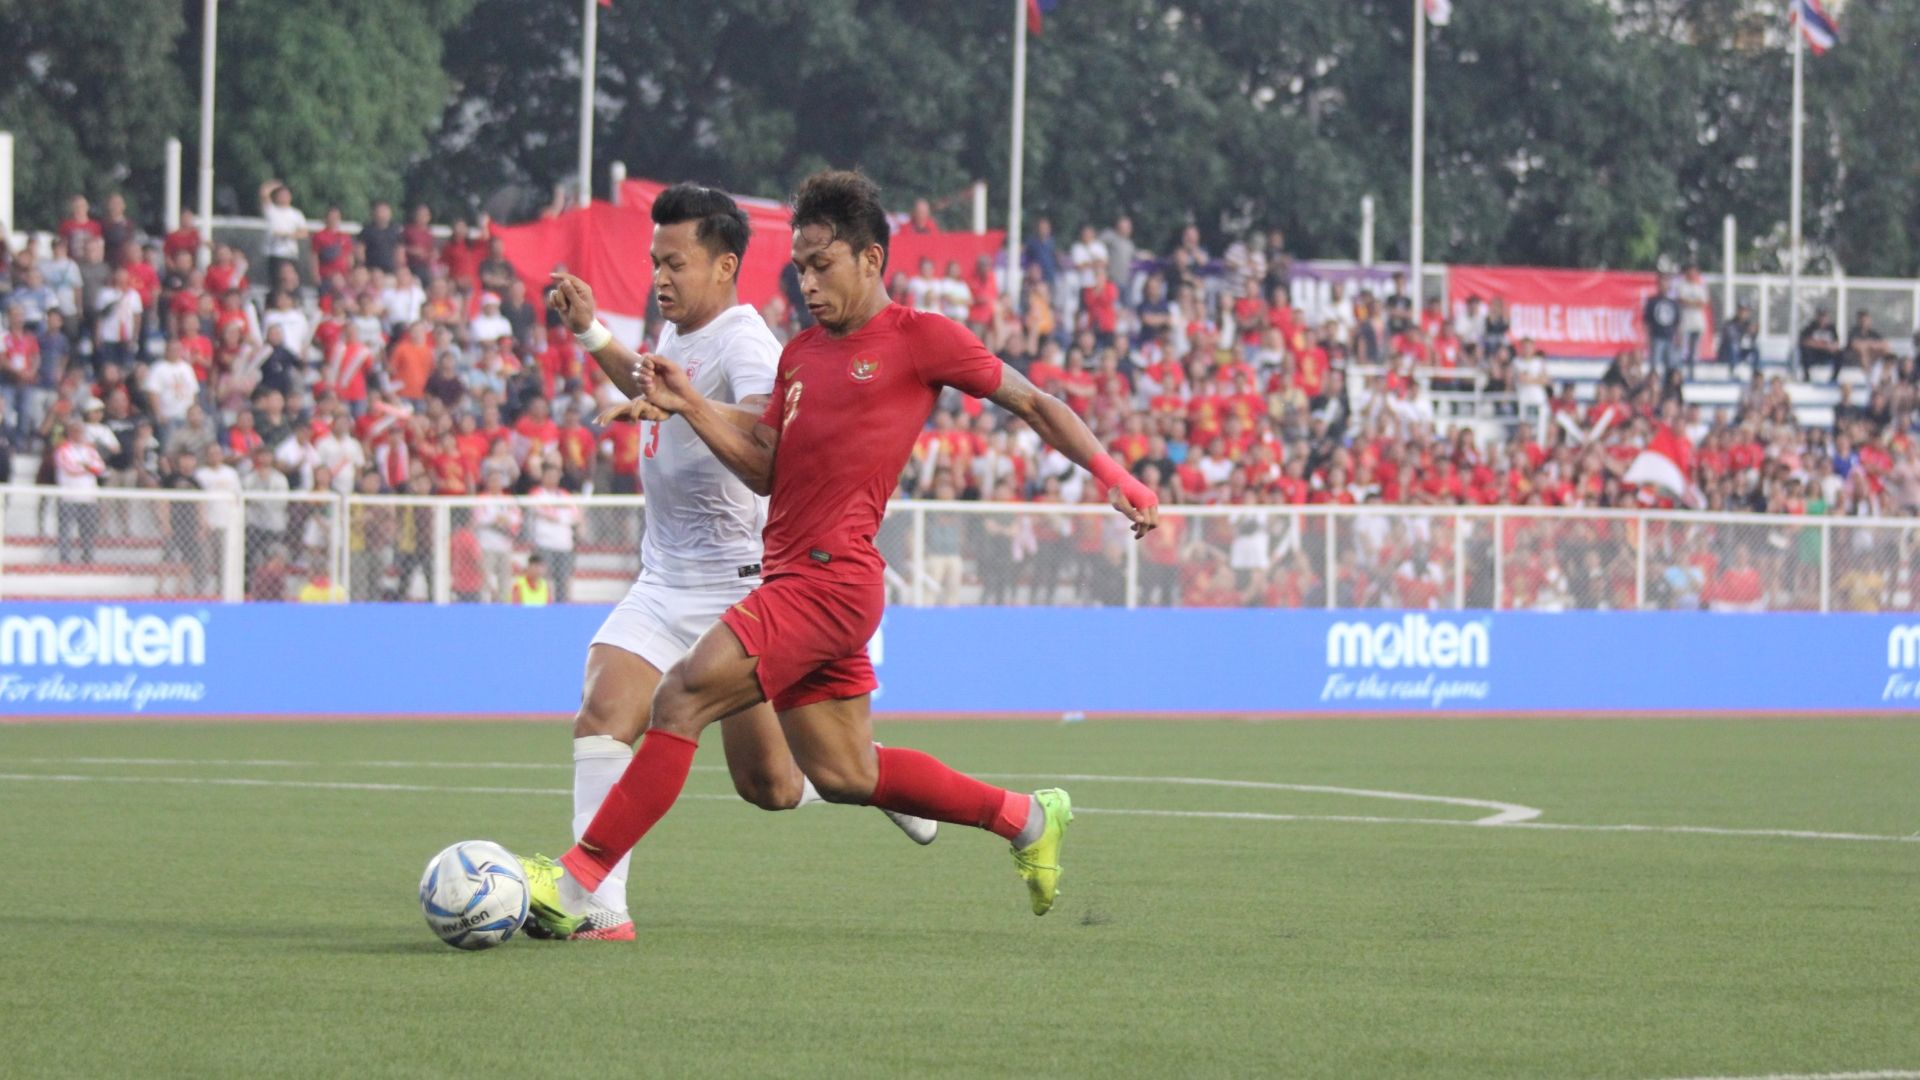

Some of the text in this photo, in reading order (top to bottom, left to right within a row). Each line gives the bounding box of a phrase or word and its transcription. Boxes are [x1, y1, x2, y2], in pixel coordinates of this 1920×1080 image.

[0, 606, 206, 667] molten
[1327, 613, 1490, 669] molten
[36, 672, 79, 701] the
[80, 672, 138, 701] real
[131, 681, 206, 712] game
[1320, 672, 1489, 709] For the real game
[441, 910, 490, 933] molten
